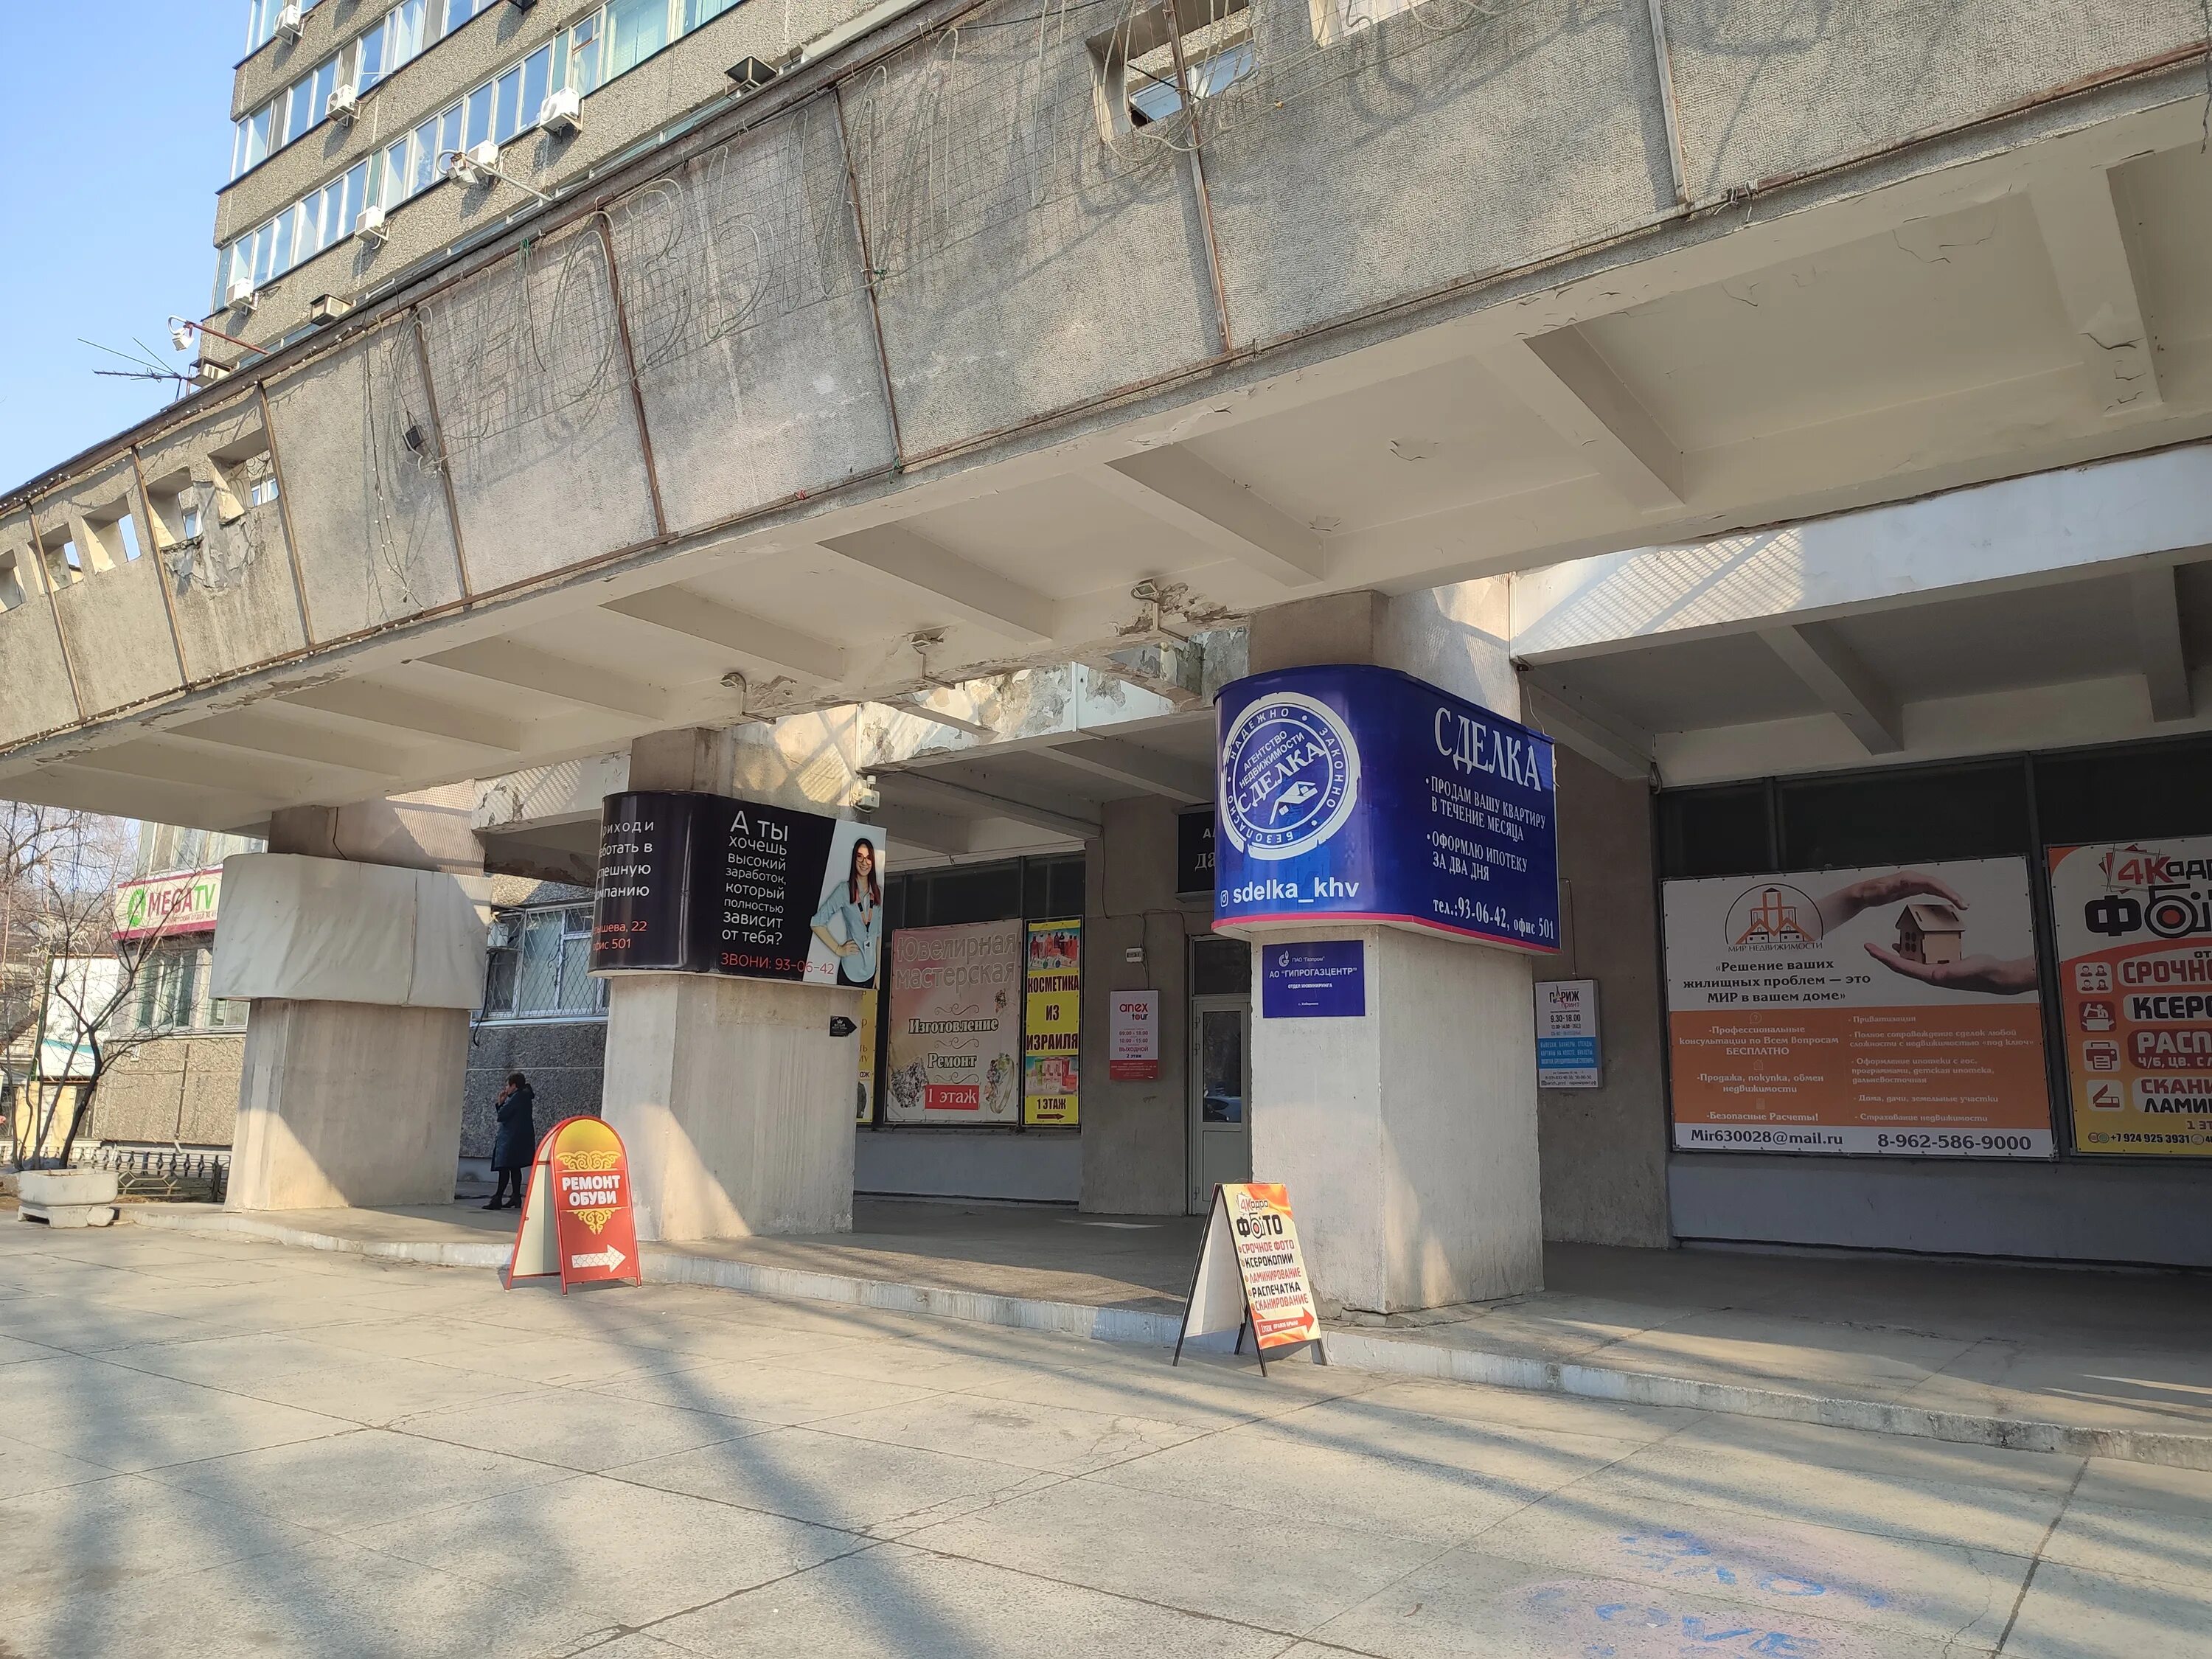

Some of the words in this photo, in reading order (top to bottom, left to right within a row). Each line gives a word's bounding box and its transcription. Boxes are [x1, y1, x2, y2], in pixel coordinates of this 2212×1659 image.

[1230, 707, 1290, 760] НАДЕЖНО
[1242, 730, 1288, 772] АГЕНТСТВО
[1434, 707, 1542, 792] СДЕЛКА
[1239, 731, 1305, 790] НЕДВИЖИМОСТИ
[1319, 727, 1344, 808] ЗАКОННО
[1237, 740, 1326, 813] СДЕЛКА
[1431, 775, 1472, 804] ПРОДАМ
[1474, 790, 1500, 814] ВАШУ
[1502, 799, 1546, 830] КВАРТИРУ
[730, 810, 750, 835] А
[757, 820, 790, 842] ты
[1227, 794, 1294, 842] БЕЗОПАСНО
[1432, 796, 1439, 812] В
[1440, 798, 1485, 827] ТЕЧЕНИЕ
[1486, 810, 1524, 842] МЕСЯЦА
[601, 819, 655, 838] риходи
[599, 842, 639, 858] аботать
[644, 843, 653, 853] в
[728, 835, 787, 856] хочешь
[1433, 831, 1484, 859] ОФОРМЛЮ
[1486, 846, 1528, 874] ИПОТЕКУ
[727, 852, 787, 872] высокий
[1433, 851, 1447, 869] ЗА
[1449, 855, 1468, 877] ДВА
[1470, 862, 1490, 883] ДНЯ
[726, 866, 787, 886] заработок,
[595, 885, 650, 901] омпанию
[726, 882, 785, 901] который
[1232, 877, 1360, 905] sdelka_khv
[724, 897, 784, 914] полностью
[631, 920, 648, 933] 22
[723, 911, 783, 929] зависит
[1514, 918, 1536, 937] офис
[1538, 917, 1554, 940] 501
[612, 938, 631, 950] 501
[722, 929, 739, 942] от
[742, 931, 783, 946] тебя?
[897, 931, 1017, 963] Ювелирная
[1728, 945, 1747, 953] МИР
[1748, 942, 1823, 952] НЕДВИЖИМОСТИ
[721, 952, 772, 970] ЗВОНИ:
[775, 959, 835, 975] 93-06-42
[1715, 961, 1784, 973] «Решение
[1787, 960, 1834, 970] ваших
[894, 960, 1015, 992] мастерская
[1269, 970, 1280, 978] АО
[1683, 978, 1760, 990] жилищных
[1763, 975, 1825, 989] проблем
[1846, 975, 1871, 985] это
[1026, 974, 1079, 994] КОСМЕТИКА
[1708, 992, 1739, 1004] МИР
[1741, 994, 1748, 1002] в
[1753, 993, 1799, 1003] вашем
[1802, 992, 1846, 1004] доме»
[1046, 1004, 1060, 1021] ИЗ
[1119, 1003, 1148, 1012] anex
[908, 1015, 1000, 1035] Изготовление
[1853, 1016, 1916, 1024] Приватизация
[1026, 1032, 1079, 1051] ИЗРАИЛЯ
[1680, 1037, 1746, 1046] консультации
[1791, 1037, 1839, 1046] вопросам
[1854, 1031, 1885, 1039] Полное
[1726, 1047, 1790, 1055] БЕСПЛАТНО
[927, 1052, 978, 1069] Ремонт
[1856, 1058, 1910, 1066] Оформление
[1913, 1057, 1951, 1065] ипотеки
[1748, 1074, 1790, 1083] покупка,
[1793, 1074, 1823, 1082] обмен
[1913, 1067, 1950, 1075] детская
[928, 1088, 933, 1104] 1
[939, 1089, 977, 1105] этаж
[1723, 1085, 1797, 1093] недвижимости
[1042, 1098, 1067, 1110] ЭТАЖ
[1960, 1096, 1999, 1105] участки
[2144, 1098, 2212, 1113] ЛАМИ
[1770, 1113, 1819, 1121] Расчеты!
[1860, 1113, 1918, 1121] Страхование
[1920, 1114, 1988, 1122] недвижимости
[2187, 1120, 2196, 1130] 1
[1690, 1129, 1843, 1146] Mir630028@mail.ru
[1877, 1133, 2032, 1150] 8-962-586-9000
[2110, 1133, 2121, 1143] +7
[2124, 1133, 2142, 1143] 924
[2144, 1134, 2163, 1144] 925
[2165, 1134, 2190, 1144] 3931
[562, 1175, 621, 1192] РЕМОНТ
[568, 1190, 618, 1206] ОБУВИ
[1242, 1242, 1273, 1254] СРОЧНОЕ
[1274, 1239, 1295, 1251] ФОТО
[1245, 1253, 1294, 1268] КСЕРОКОПИИ
[1249, 1267, 1302, 1284] ЛАМИНИРОВАНИЕ
[1252, 1281, 1301, 1298] РАСПЕЧАТКА
[1255, 1294, 1310, 1312] СКАНИРОВАНИЕ
